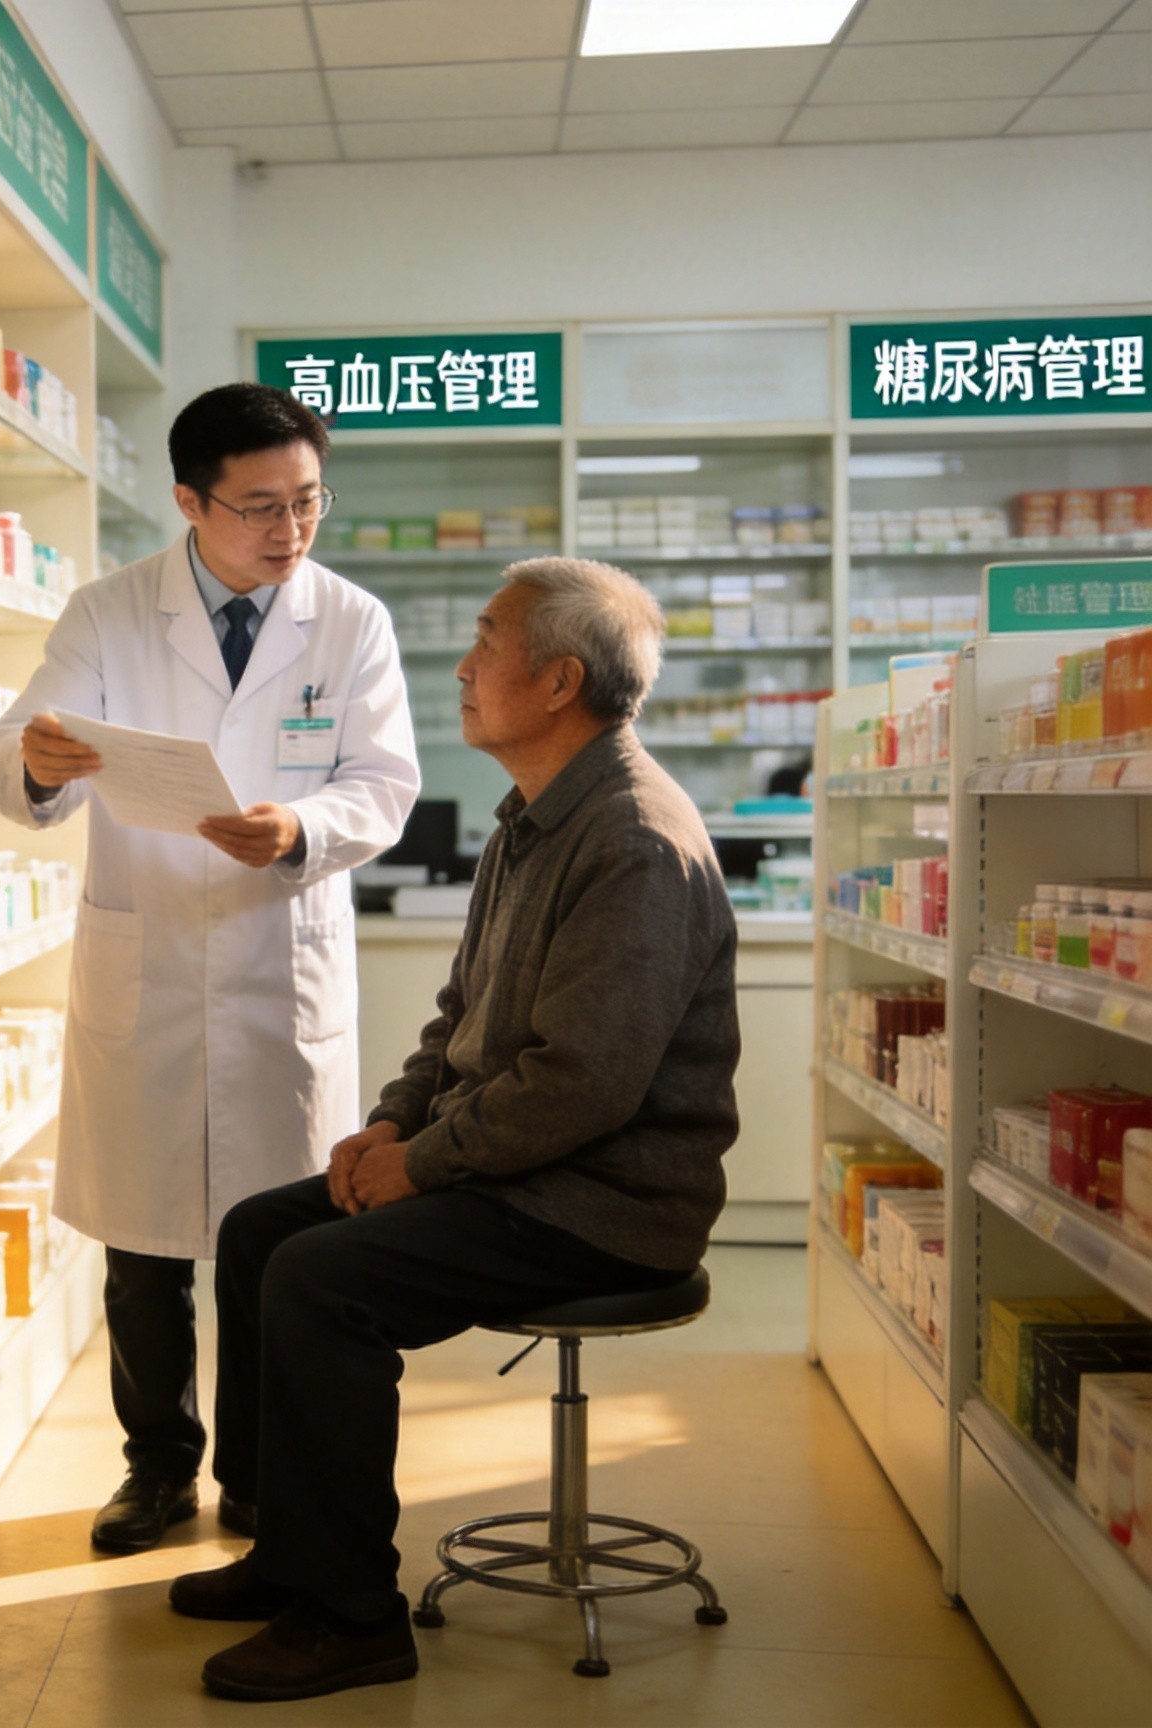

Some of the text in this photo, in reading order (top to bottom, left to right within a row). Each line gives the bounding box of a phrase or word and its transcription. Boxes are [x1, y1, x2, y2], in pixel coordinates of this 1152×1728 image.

[285, 349, 539, 415] 高血压管理
[873, 333, 1147, 406] 糖尿病管理
